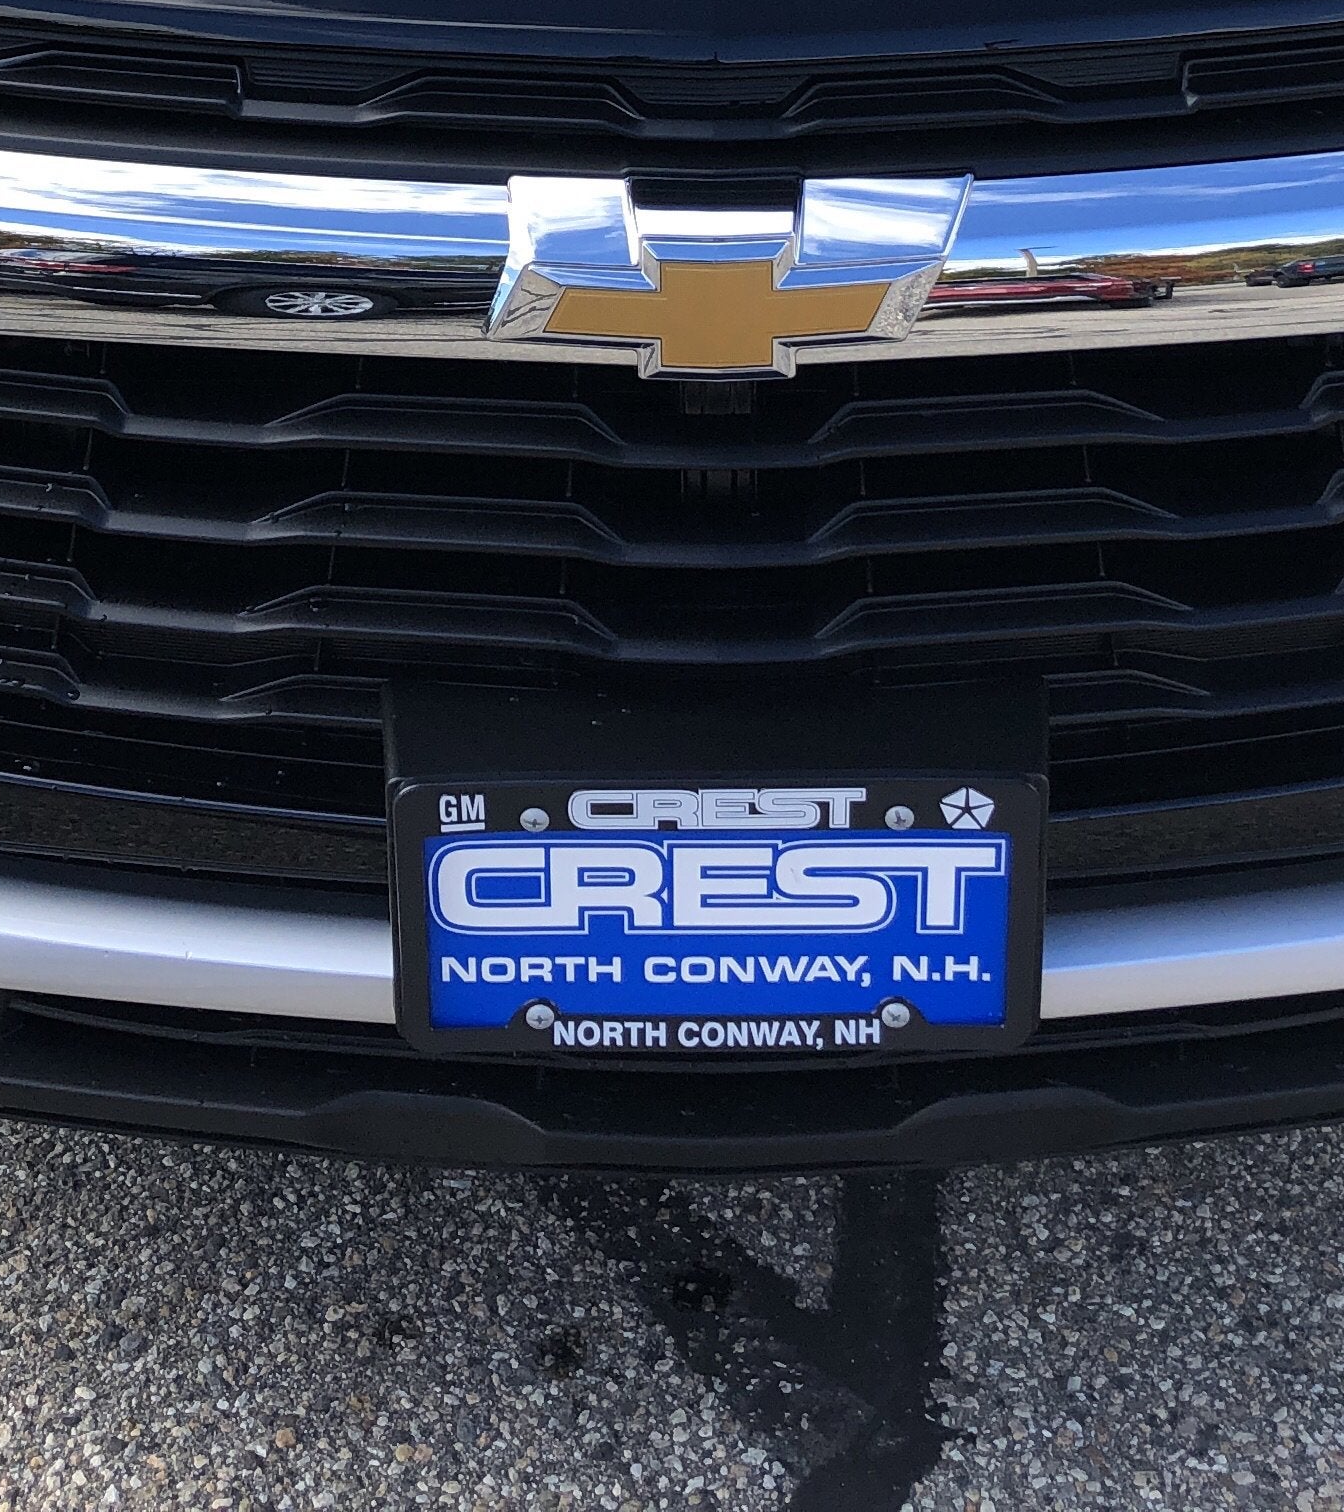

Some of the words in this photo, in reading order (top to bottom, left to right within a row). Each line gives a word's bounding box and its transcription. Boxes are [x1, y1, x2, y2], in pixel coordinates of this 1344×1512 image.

[439, 793, 486, 823] GM
[567, 787, 867, 830] CREST
[428, 838, 1007, 936] CREST
[441, 956, 623, 983] NORTH
[643, 954, 872, 988] CONWAY,
[892, 954, 992, 983] N.H.
[553, 1020, 667, 1047] NORTH
[677, 1018, 825, 1051] CONWAY,
[834, 1017, 882, 1045] NH
